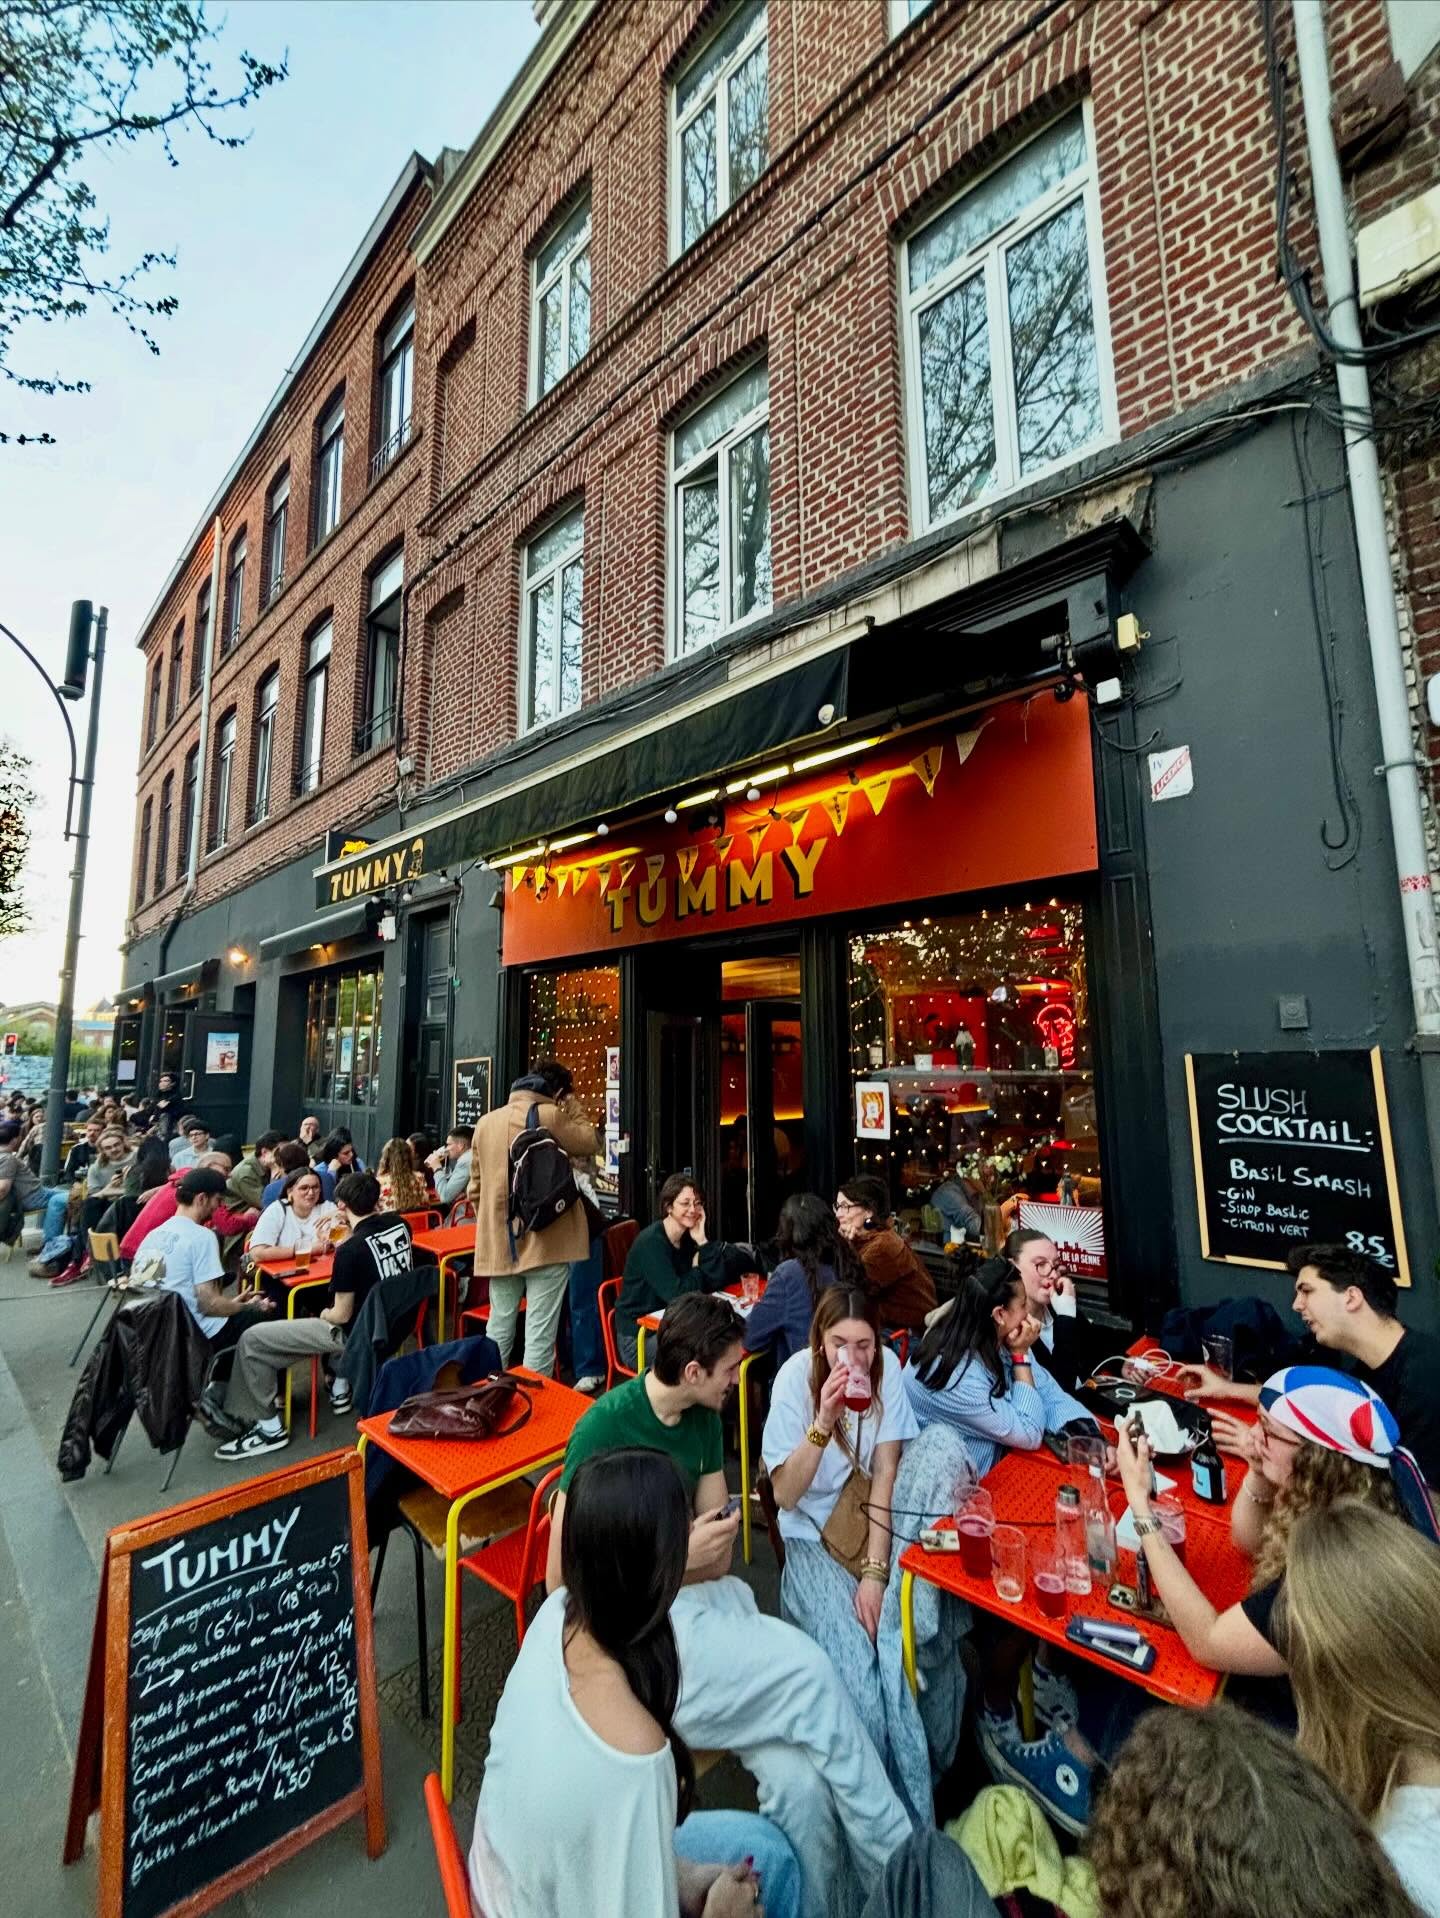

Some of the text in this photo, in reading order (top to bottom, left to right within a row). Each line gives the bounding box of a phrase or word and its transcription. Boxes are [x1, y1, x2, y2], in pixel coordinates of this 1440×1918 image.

[330, 848, 407, 902] TUMMY
[605, 838, 827, 932] TUMMY
[1216, 1082, 1307, 1115] SLUSH
[1292, 1166, 1372, 1200] SMASH
[1278, 1224, 1311, 1240] VERT
[141, 1505, 301, 1592] TUMMY
